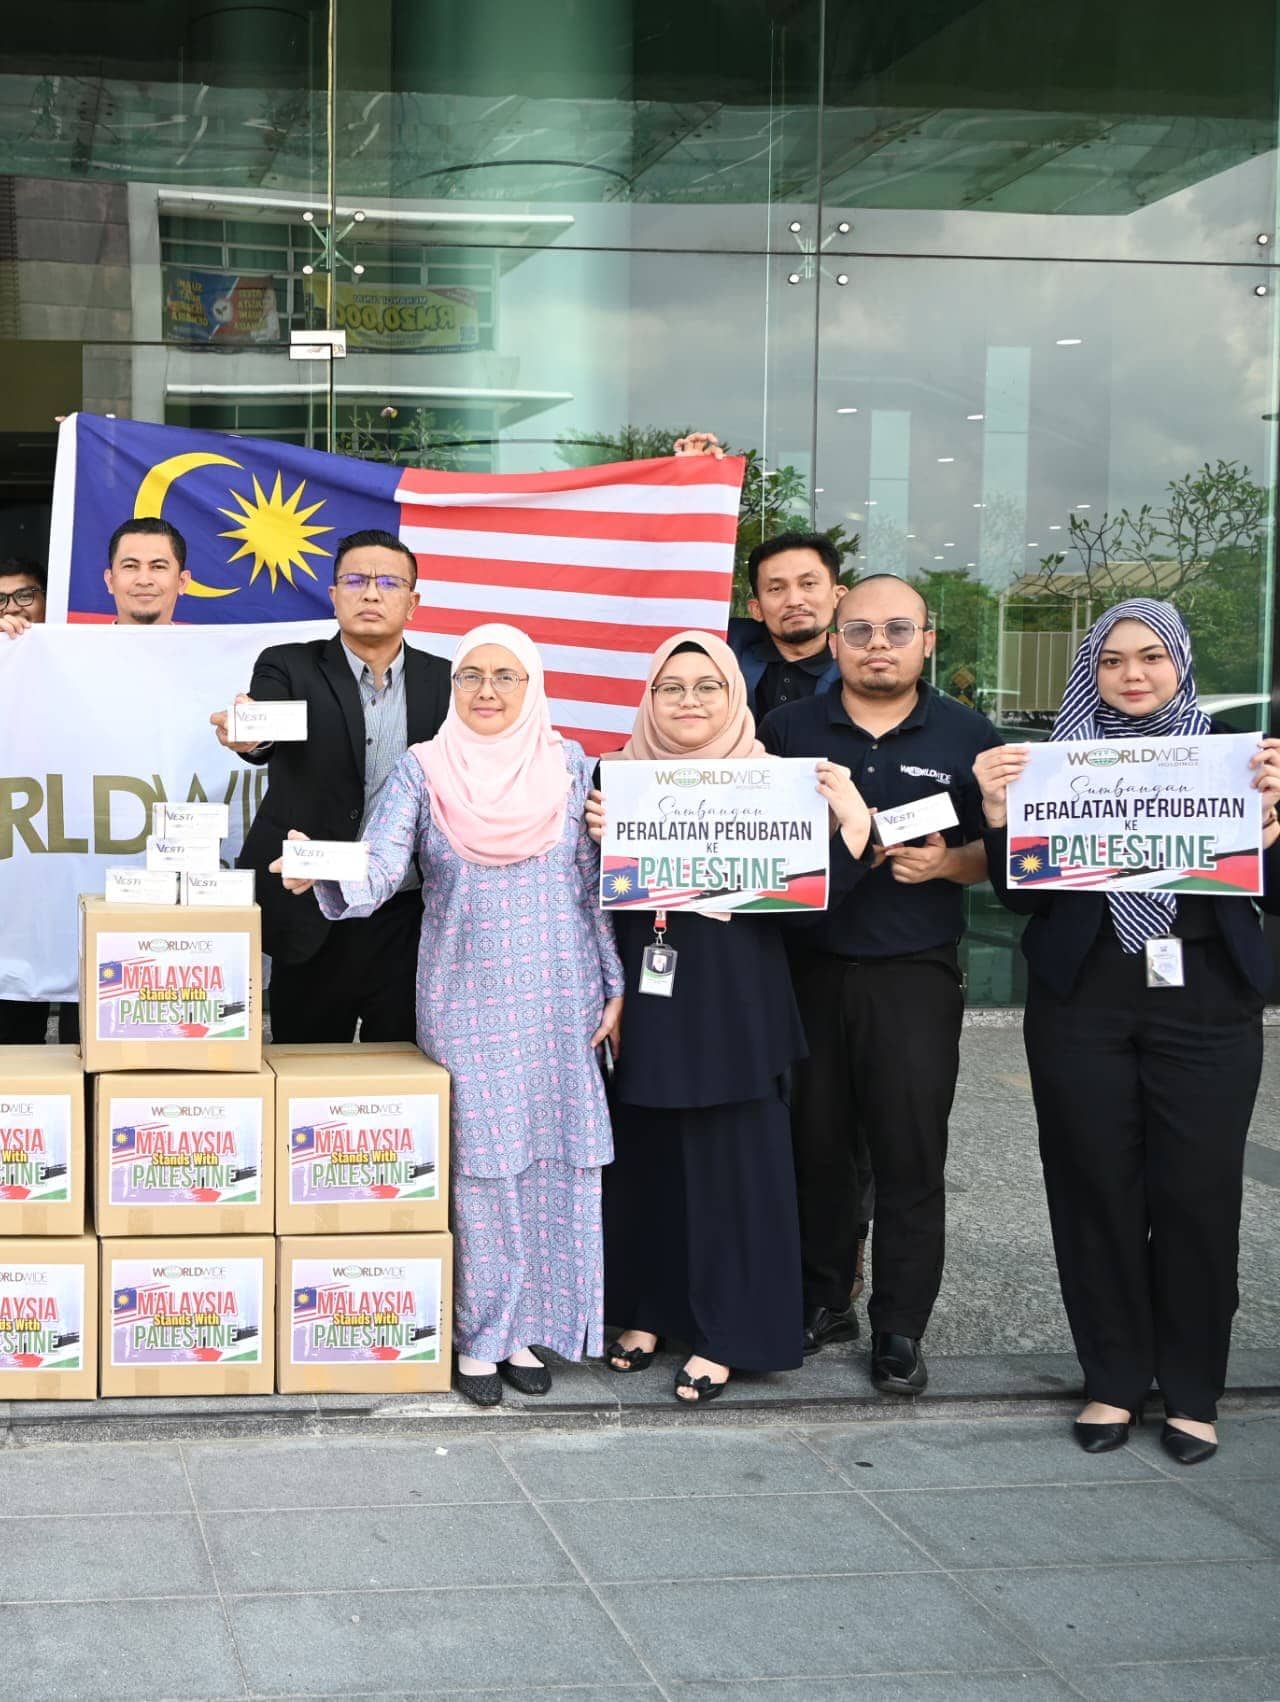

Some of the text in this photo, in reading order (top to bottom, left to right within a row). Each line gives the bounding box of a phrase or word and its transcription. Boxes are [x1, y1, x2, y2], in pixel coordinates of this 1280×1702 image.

[1070, 775, 1194, 802] Sumbangan
[658, 795, 767, 824] Sumbangan
[1024, 798, 1245, 821] PERALATAN PERUBATAN
[616, 821, 812, 841] PERALATAN PERUBATAN
[1125, 820, 1138, 831] KE
[706, 843, 718, 853] KE
[1050, 834, 1215, 868] PALESTINE
[640, 857, 787, 890] PALESTINE
[123, 966, 224, 989] MALAYSIA
[139, 988, 207, 1001] Stands With
[121, 1000, 224, 1023] PALESTINE
[136, 1131, 235, 1154] MALAYSIA
[315, 1128, 412, 1153] MALAYSIA
[2, 1150, 28, 1163] With
[152, 1152, 218, 1166] Stands With
[331, 1150, 397, 1165] Stands With
[133, 1165, 236, 1187] PALESTINE
[313, 1161, 415, 1186] PALESTINE
[138, 1291, 236, 1315] MALAYSIA
[318, 1291, 415, 1314] MALAYSIA
[15, 1319, 41, 1331] With
[154, 1313, 220, 1326] Stands With
[333, 1312, 399, 1326] Stands With
[135, 1325, 238, 1348] PALESTINE
[315, 1324, 416, 1347] PALESTINE
